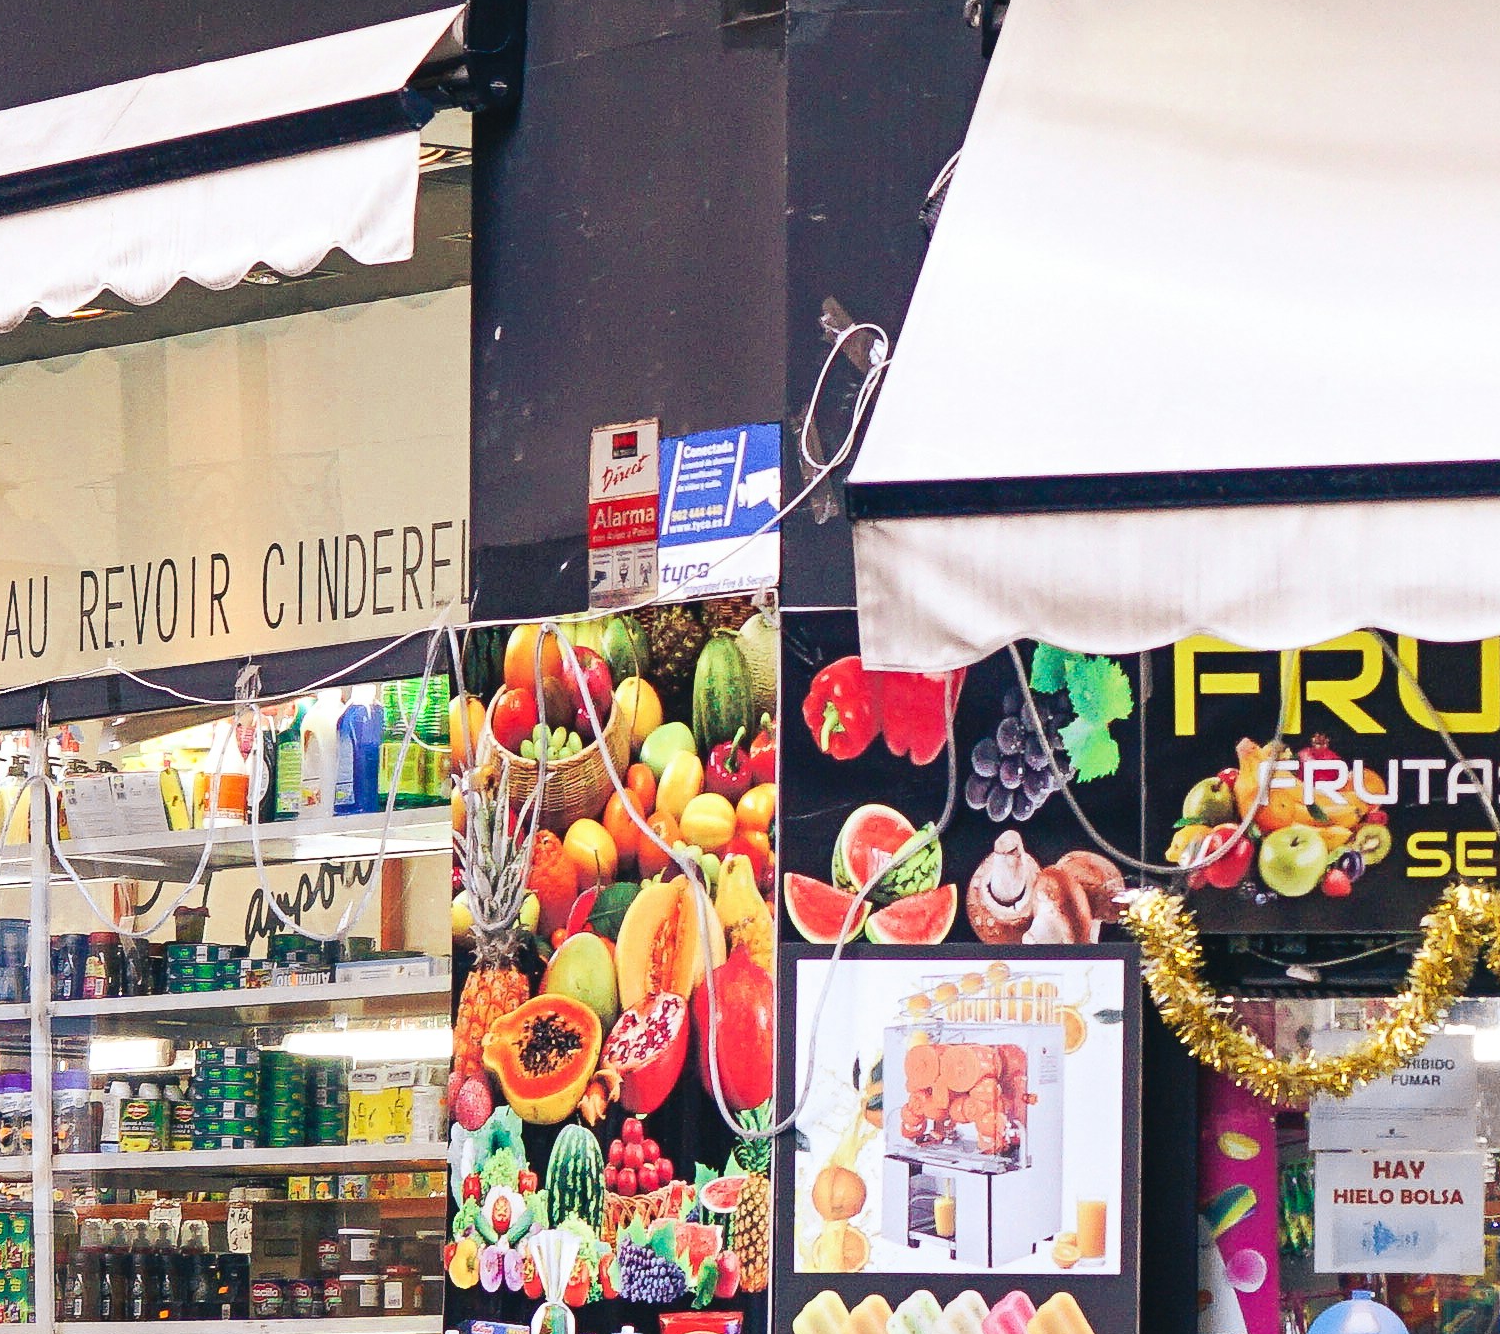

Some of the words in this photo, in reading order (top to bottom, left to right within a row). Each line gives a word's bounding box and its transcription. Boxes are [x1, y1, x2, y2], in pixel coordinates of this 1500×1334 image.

[593, 506, 655, 530] Alarma
[661, 563, 710, 584] tyco
[2, 575, 48, 661] AU
[80, 553, 230, 652] REVOIR
[1390, 1074, 1441, 1087] FUMAR
[1372, 1160, 1424, 1180] HAY
[1333, 1189, 1396, 1205] HIELO
[1401, 1189, 1464, 1205] BOLSA
